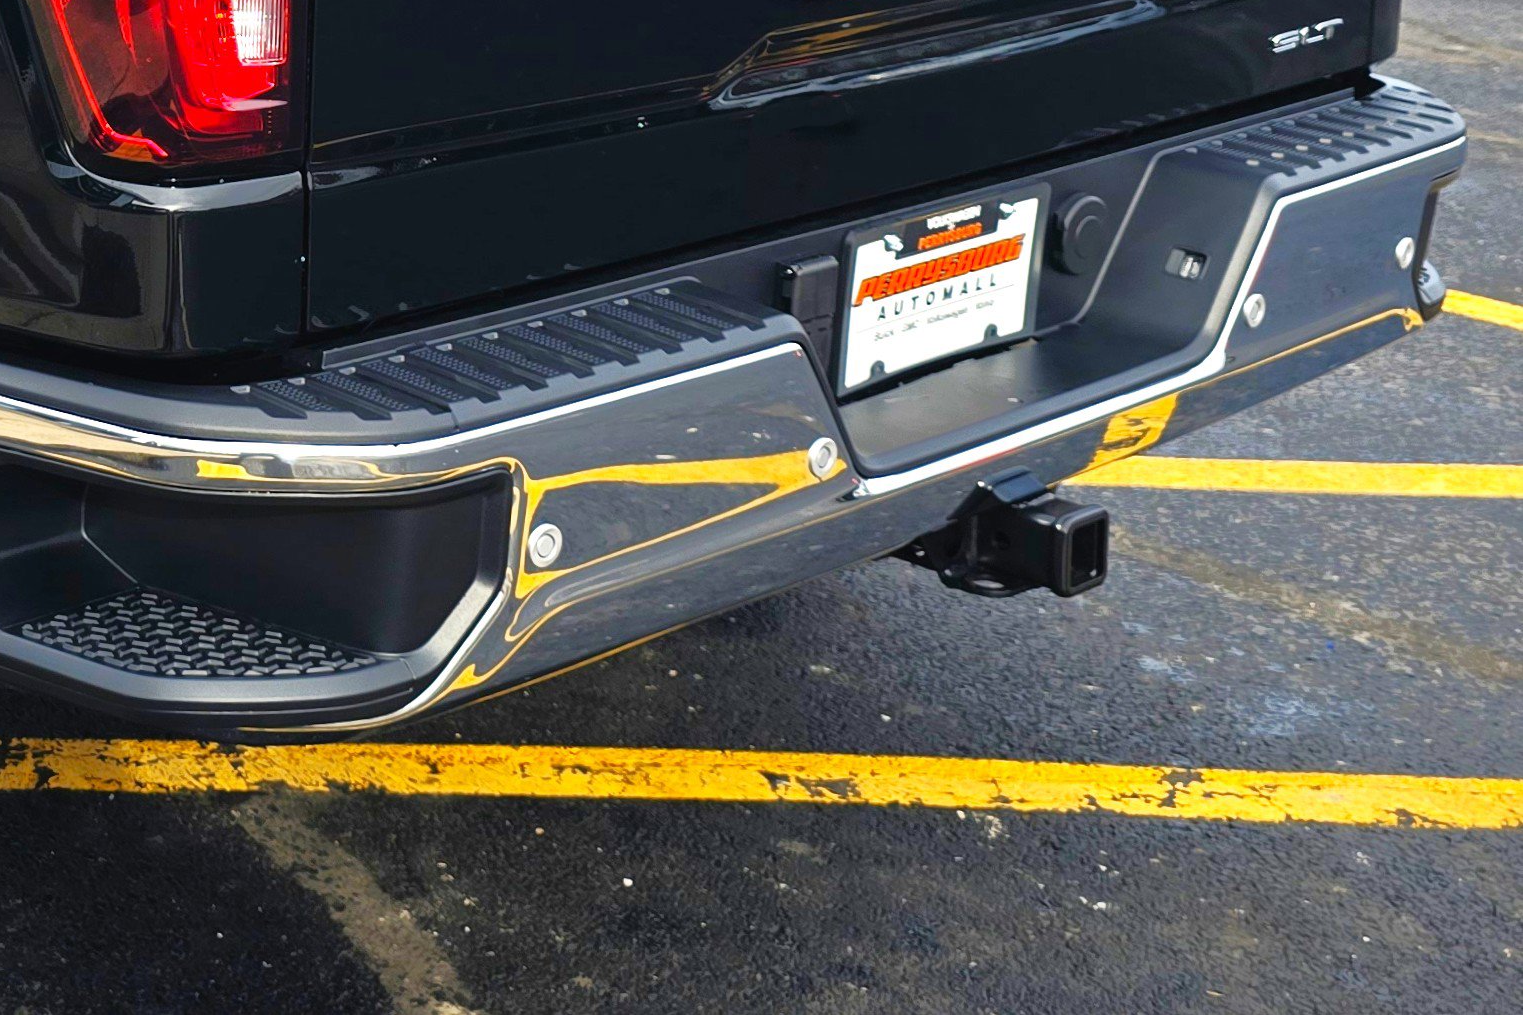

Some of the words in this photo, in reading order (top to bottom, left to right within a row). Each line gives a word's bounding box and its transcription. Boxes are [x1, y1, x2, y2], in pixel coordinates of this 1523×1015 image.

[1269, 17, 1344, 54] SLT
[851, 233, 1026, 307] PERRYSBURG
[877, 273, 997, 321] AUTOMALL
